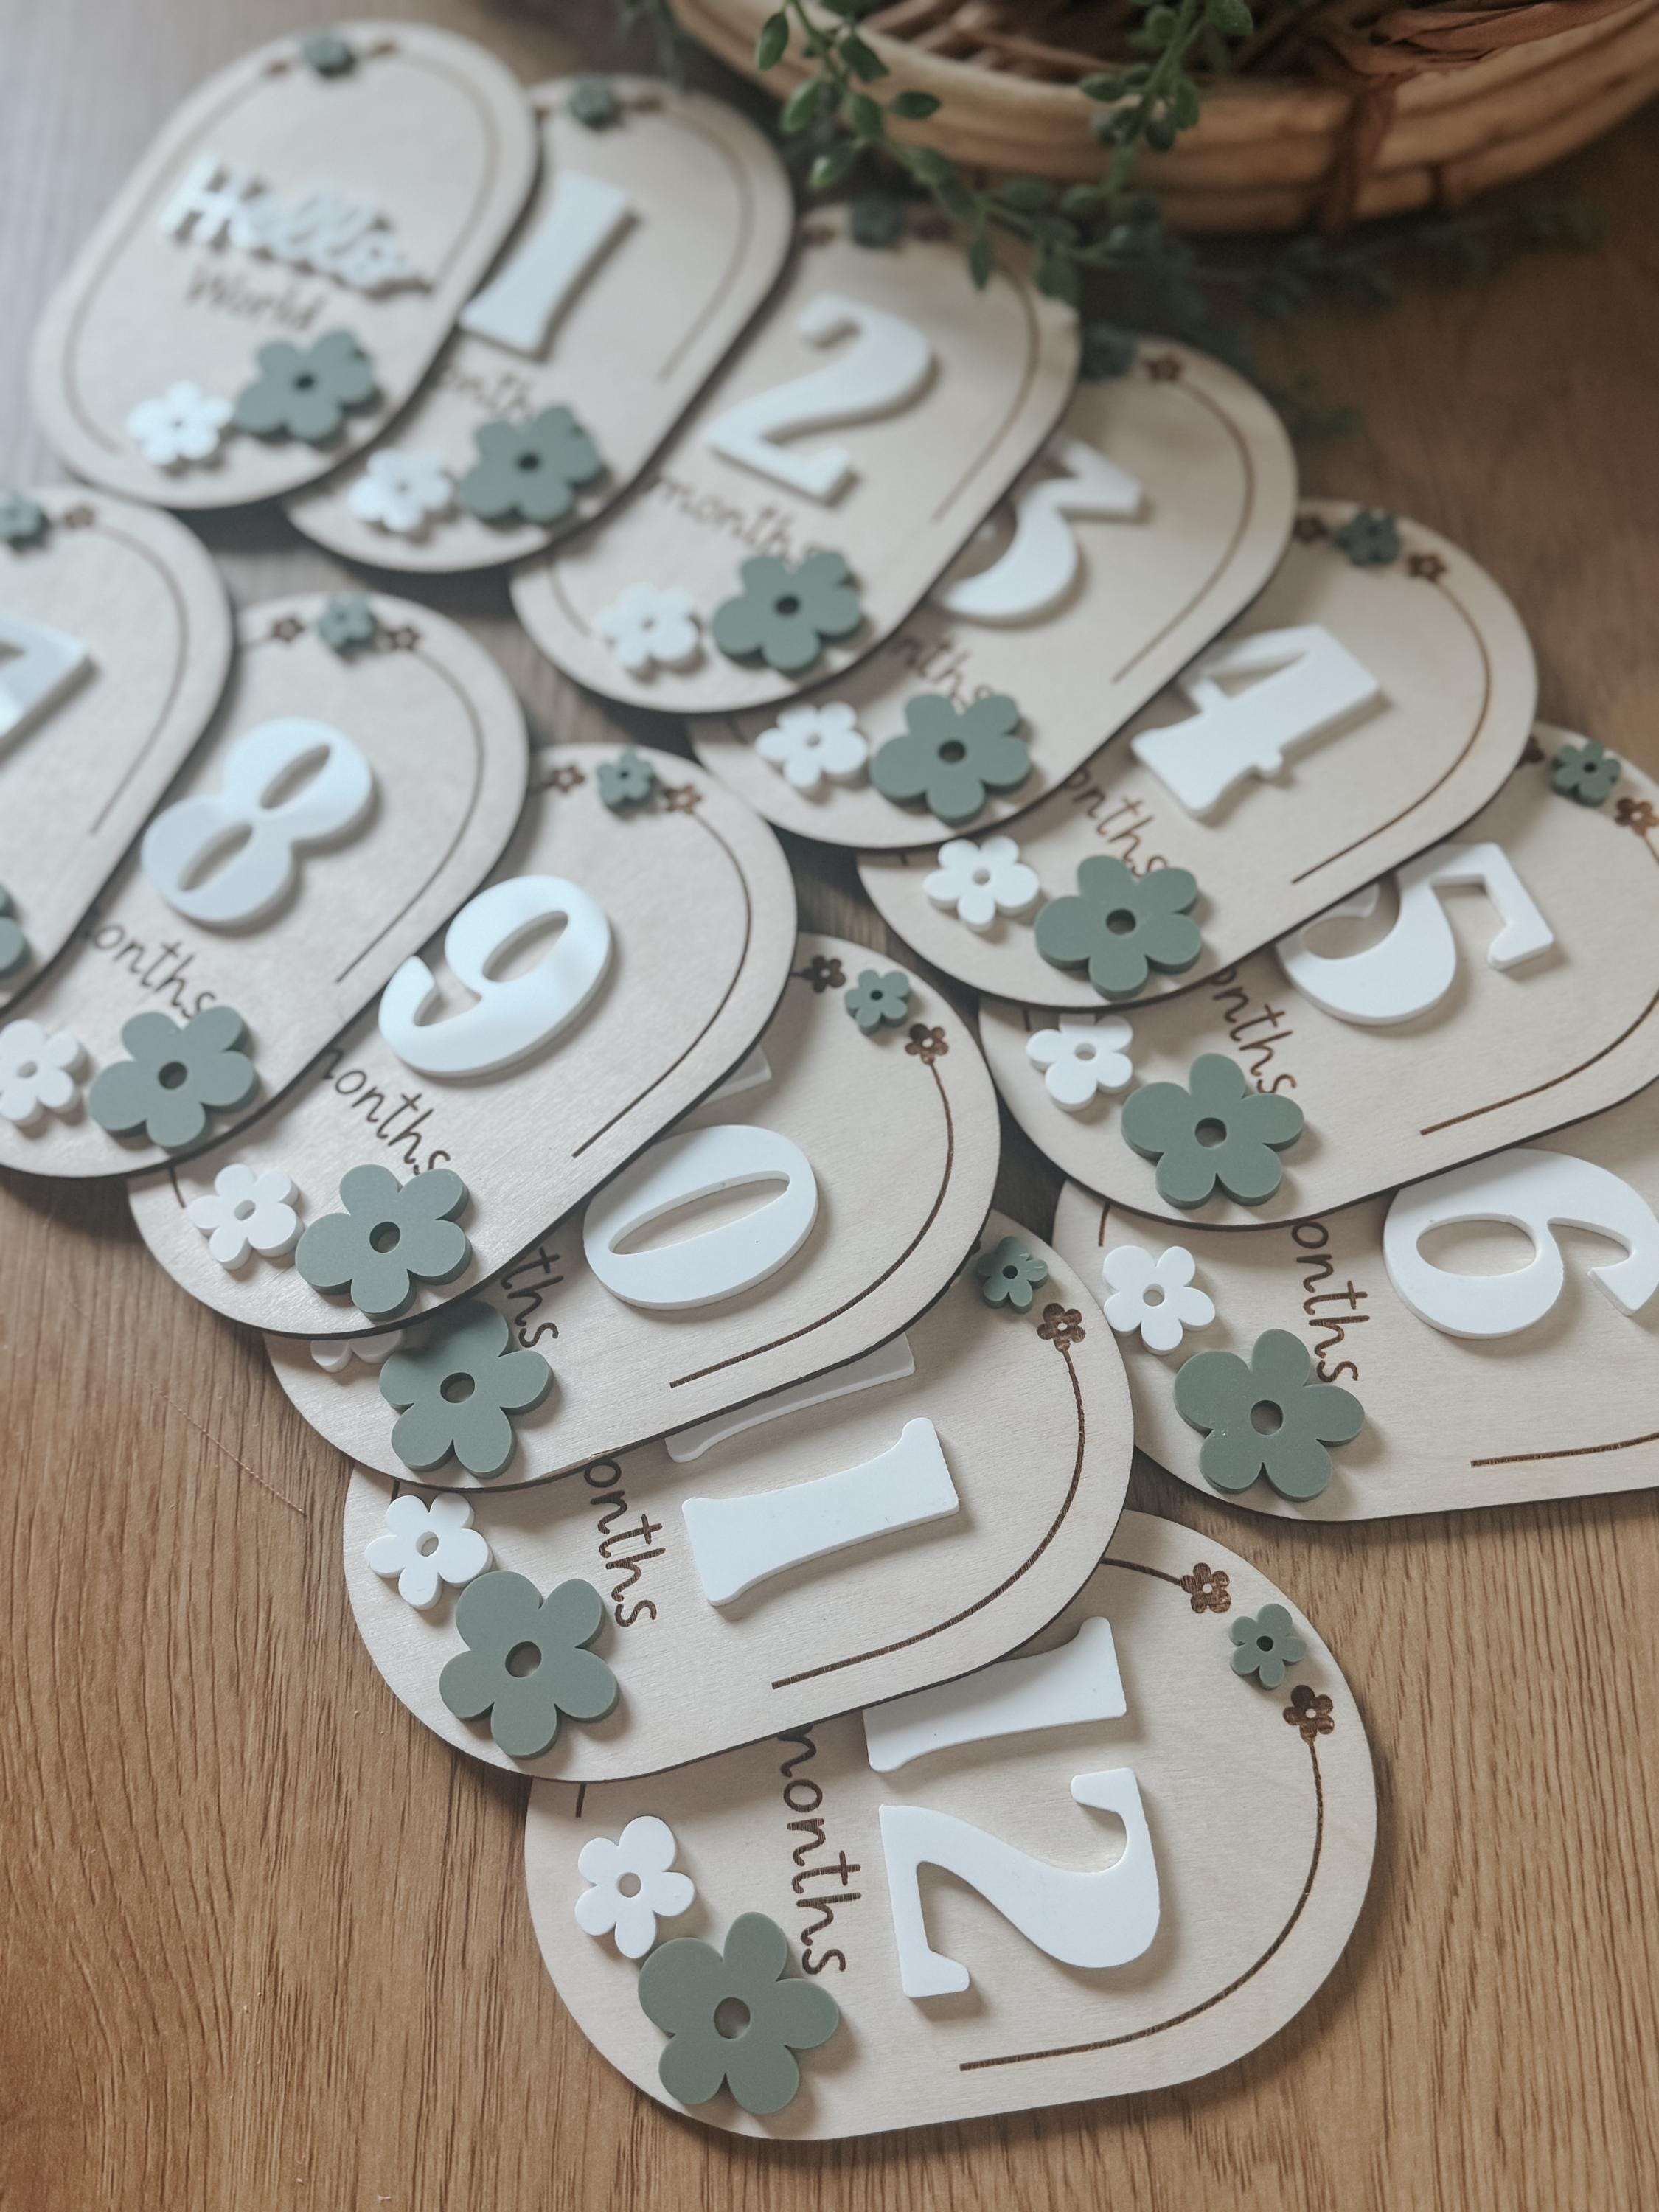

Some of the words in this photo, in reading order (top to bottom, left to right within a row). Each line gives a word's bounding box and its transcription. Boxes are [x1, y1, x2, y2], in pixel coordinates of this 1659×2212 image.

[159, 151, 422, 289] Hello
[187, 265, 329, 330] World
[706, 295, 933, 498] 2
[1130, 623, 1377, 813] 4
[142, 717, 372, 923] 8
[1067, 767, 1168, 877] onths
[93, 925, 216, 1019] onths
[378, 874, 611, 1078] 9
[1274, 841, 1556, 1026] 5
[1211, 964, 1298, 1094] onths
[1292, 1221, 1370, 1383] onths
[1382, 1149, 1659, 1340] 6
[584, 1455, 666, 1627] onths
[861, 1616, 1163, 1998] 12
